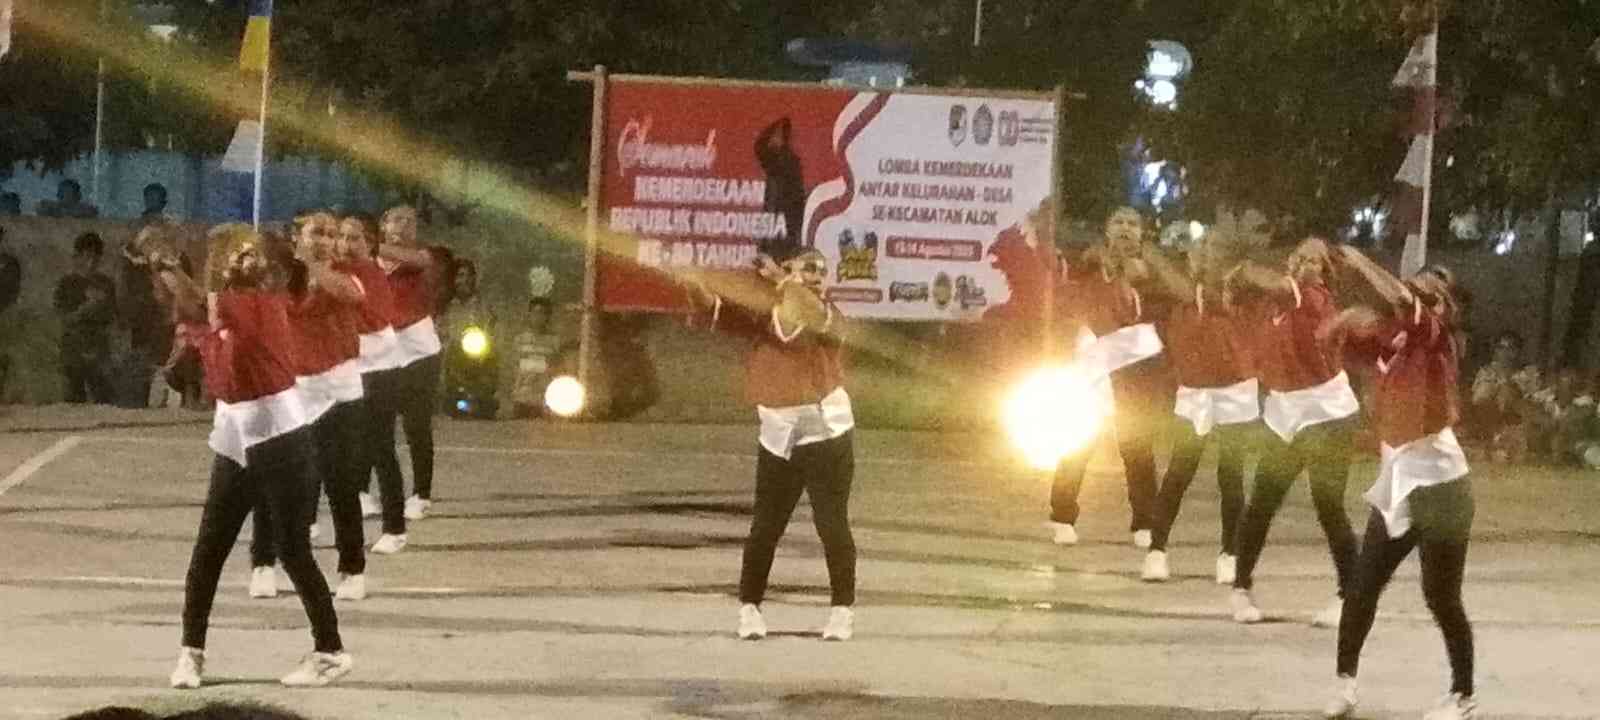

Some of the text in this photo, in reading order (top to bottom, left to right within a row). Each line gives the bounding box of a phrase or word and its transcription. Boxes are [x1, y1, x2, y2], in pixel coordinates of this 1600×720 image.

[878, 159, 1013, 178] LOMBA KEMERDEKAAN
[634, 175, 766, 205] KEMERDEKAAN
[860, 181, 899, 198] ANTAR
[901, 182, 975, 201] KELURAHAN
[984, 187, 1012, 203] DESA
[609, 207, 787, 239] REPUBLIK INDONESIA
[965, 208, 998, 225] ALOK
[695, 243, 758, 269] TAHUN
